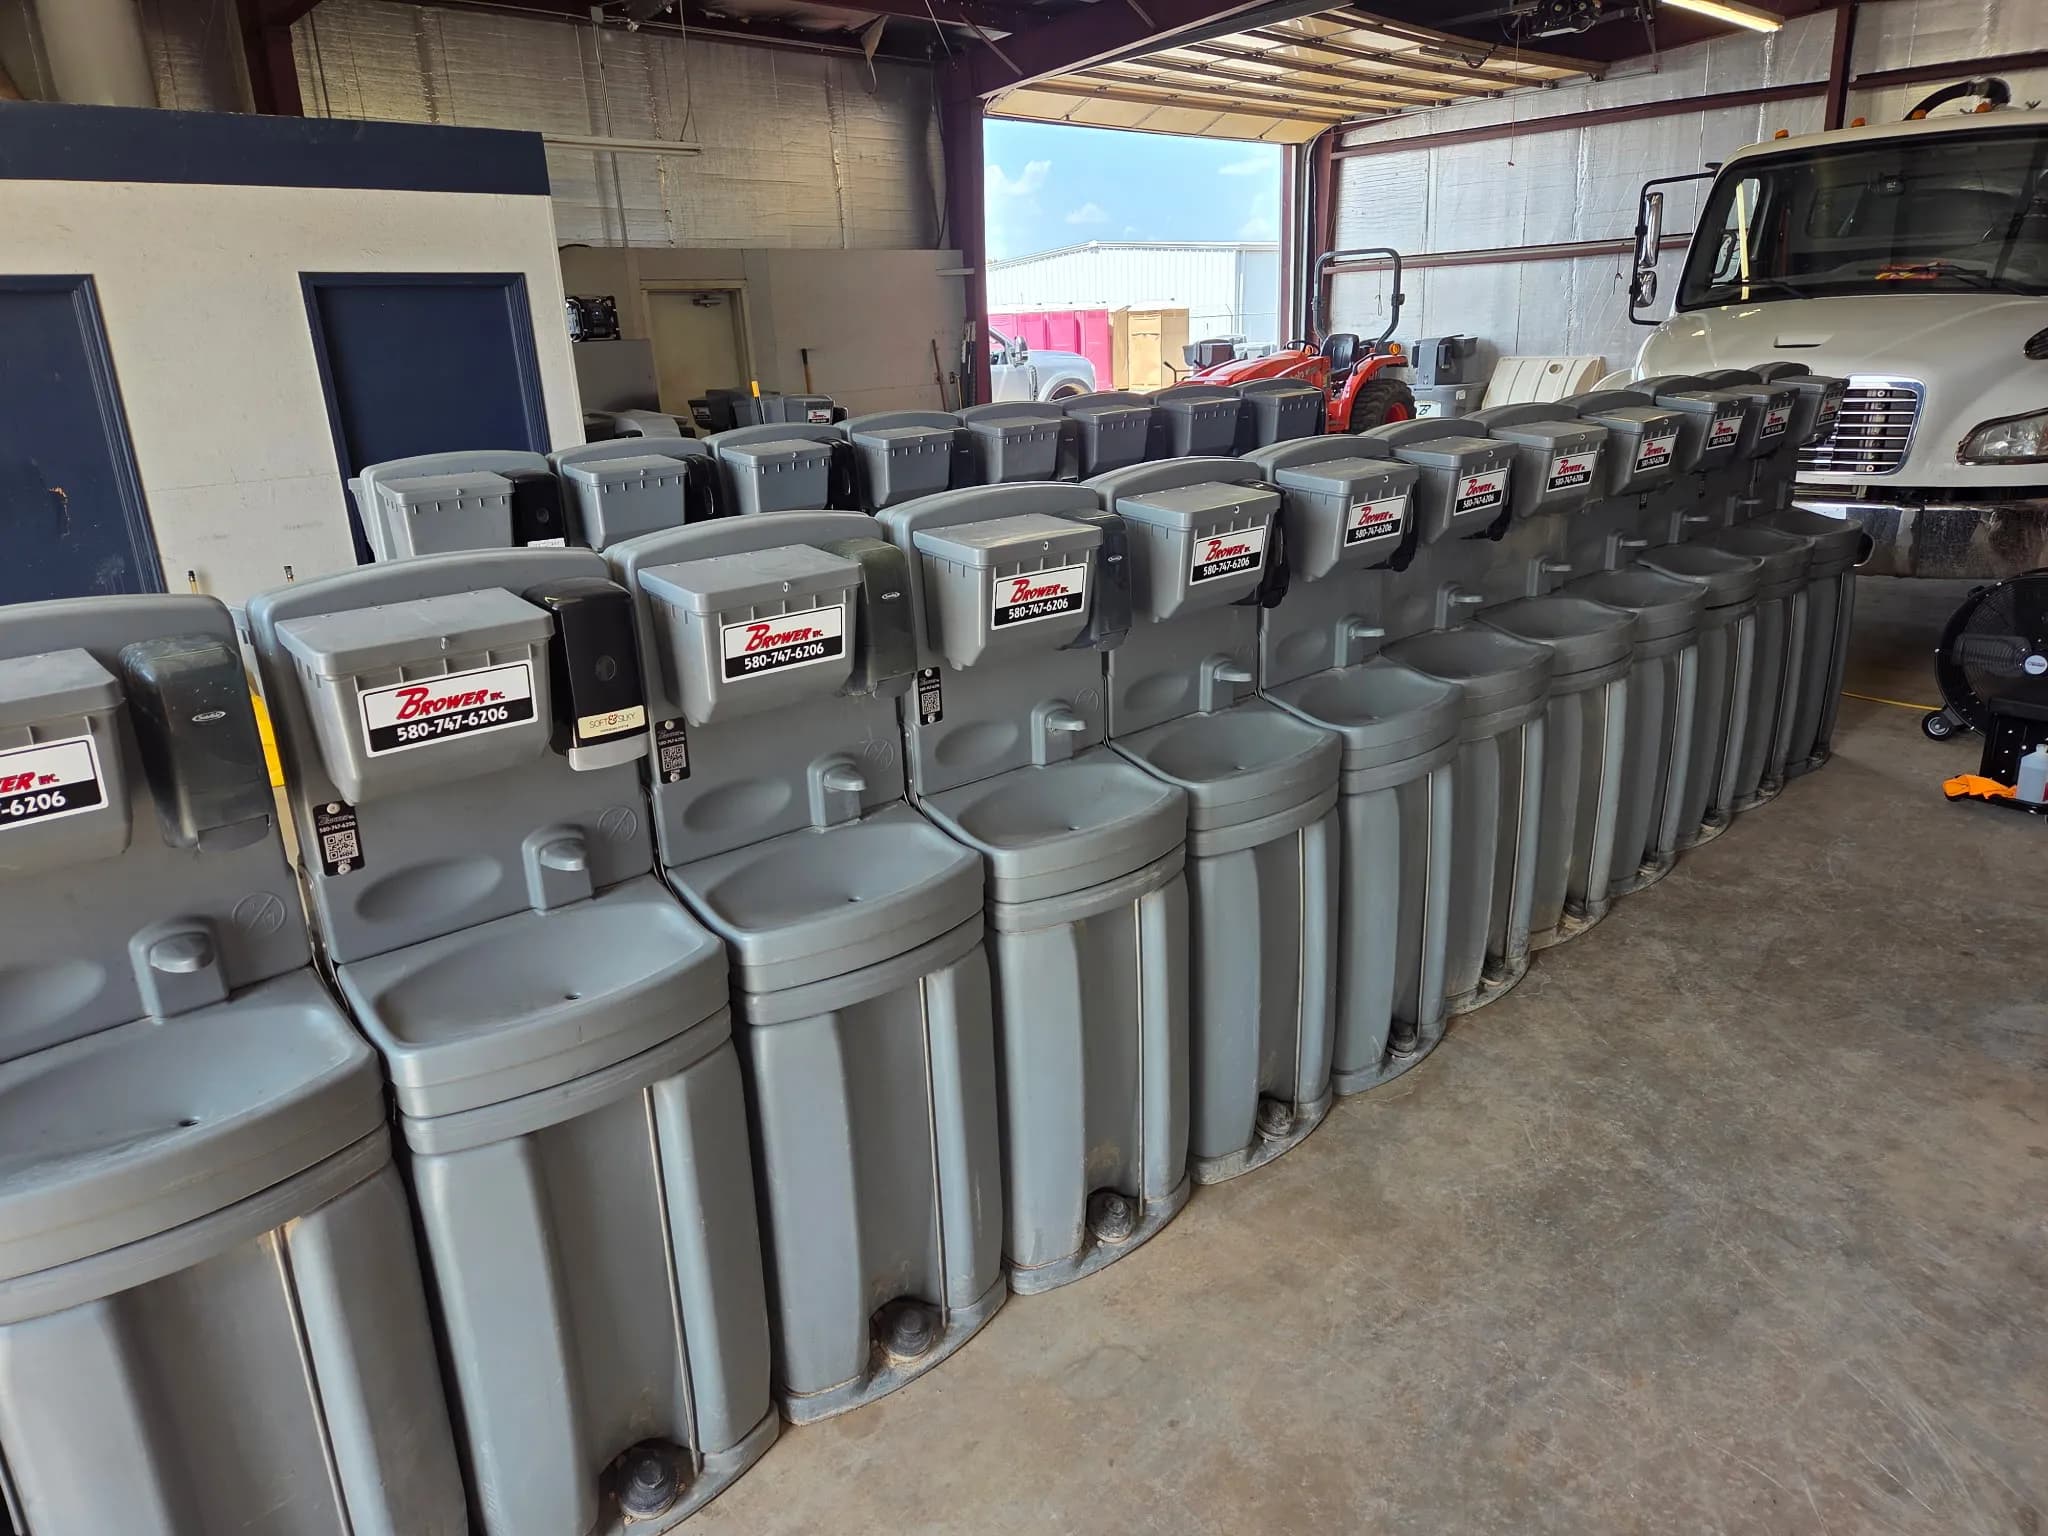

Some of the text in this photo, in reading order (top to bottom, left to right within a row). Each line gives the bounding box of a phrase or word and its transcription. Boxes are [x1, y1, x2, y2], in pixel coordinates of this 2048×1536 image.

[1466, 479, 1492, 496] BROWER
[1358, 506, 1389, 526] BROWER
[1355, 523, 1392, 539] 580-747-6206
[1205, 540, 1245, 561] BROWER
[1203, 557, 1250, 576] 580-747-6206
[1010, 579, 1061, 603] BROWER
[1008, 598, 1068, 620] 580-747-6206
[745, 624, 812, 651] BROWER
[744, 642, 824, 670] 580-747-6206
[395, 687, 489, 720] BROWER
[396, 706, 508, 742] 580-747-6206
[0, 790, 66, 816] -6206
